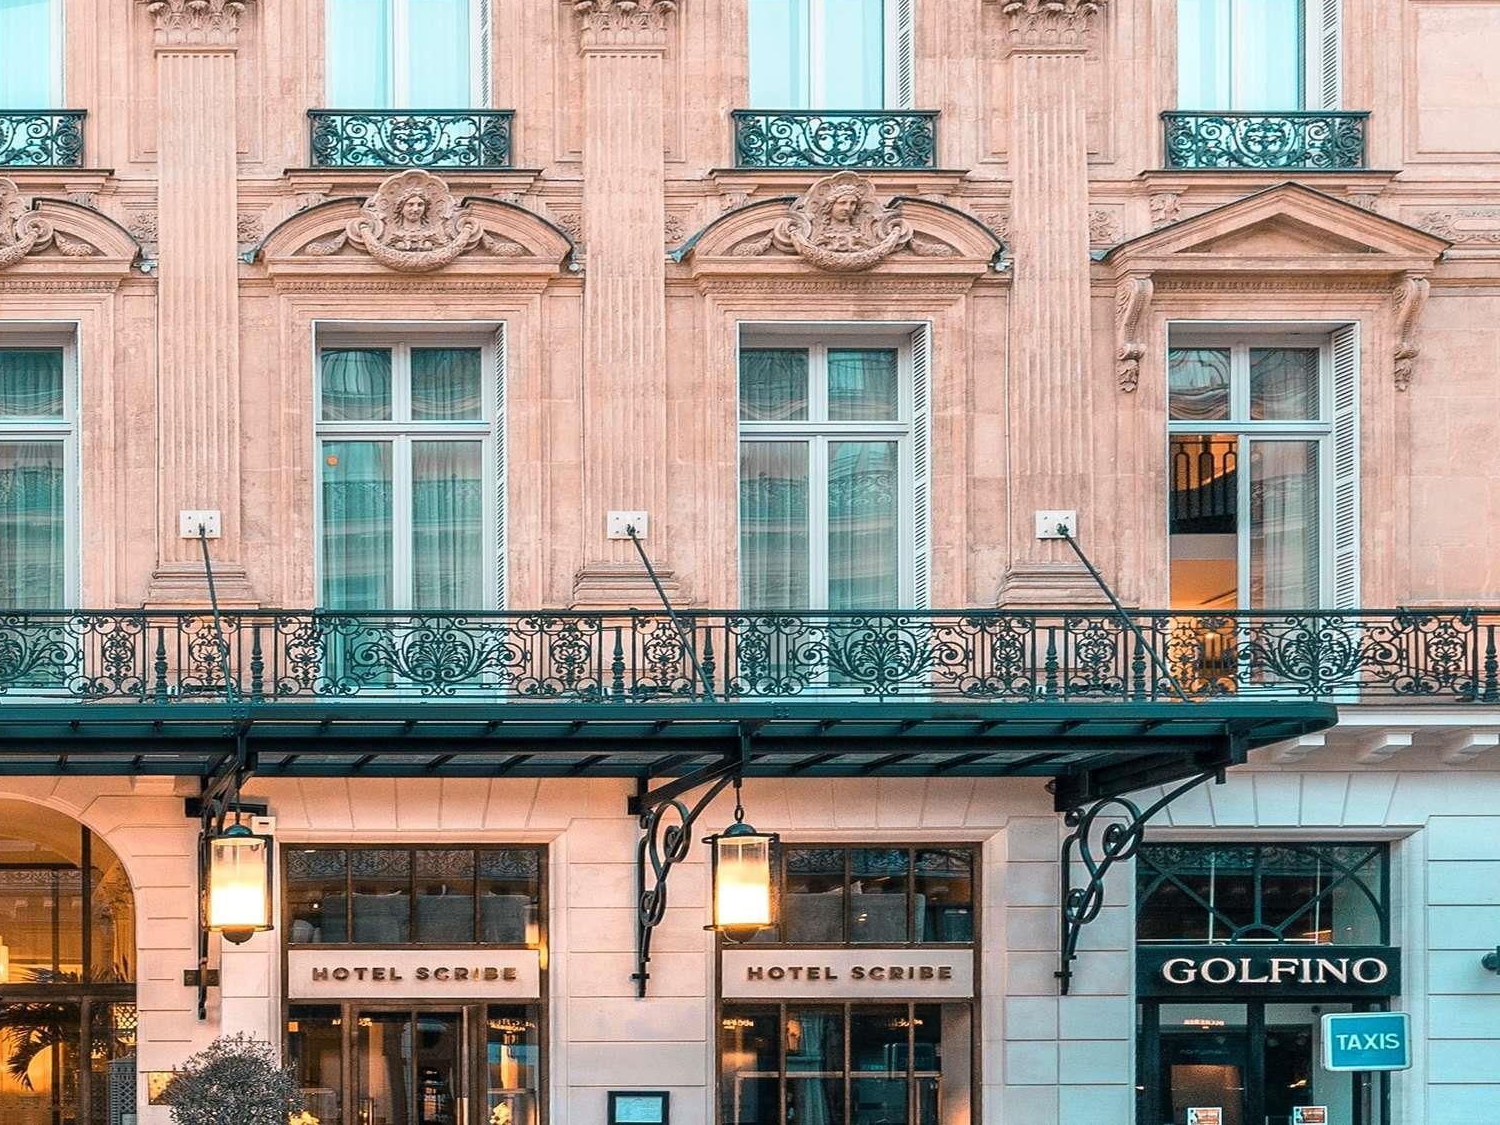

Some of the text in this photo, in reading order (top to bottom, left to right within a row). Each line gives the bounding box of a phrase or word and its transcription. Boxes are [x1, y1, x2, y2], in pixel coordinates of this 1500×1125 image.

[312, 967, 517, 981] HOTEL SCRIBE
[747, 966, 952, 980] HOTEL SCRIBE
[1162, 958, 1388, 984] GOLFINO
[1335, 1033, 1400, 1051] TAXIS
